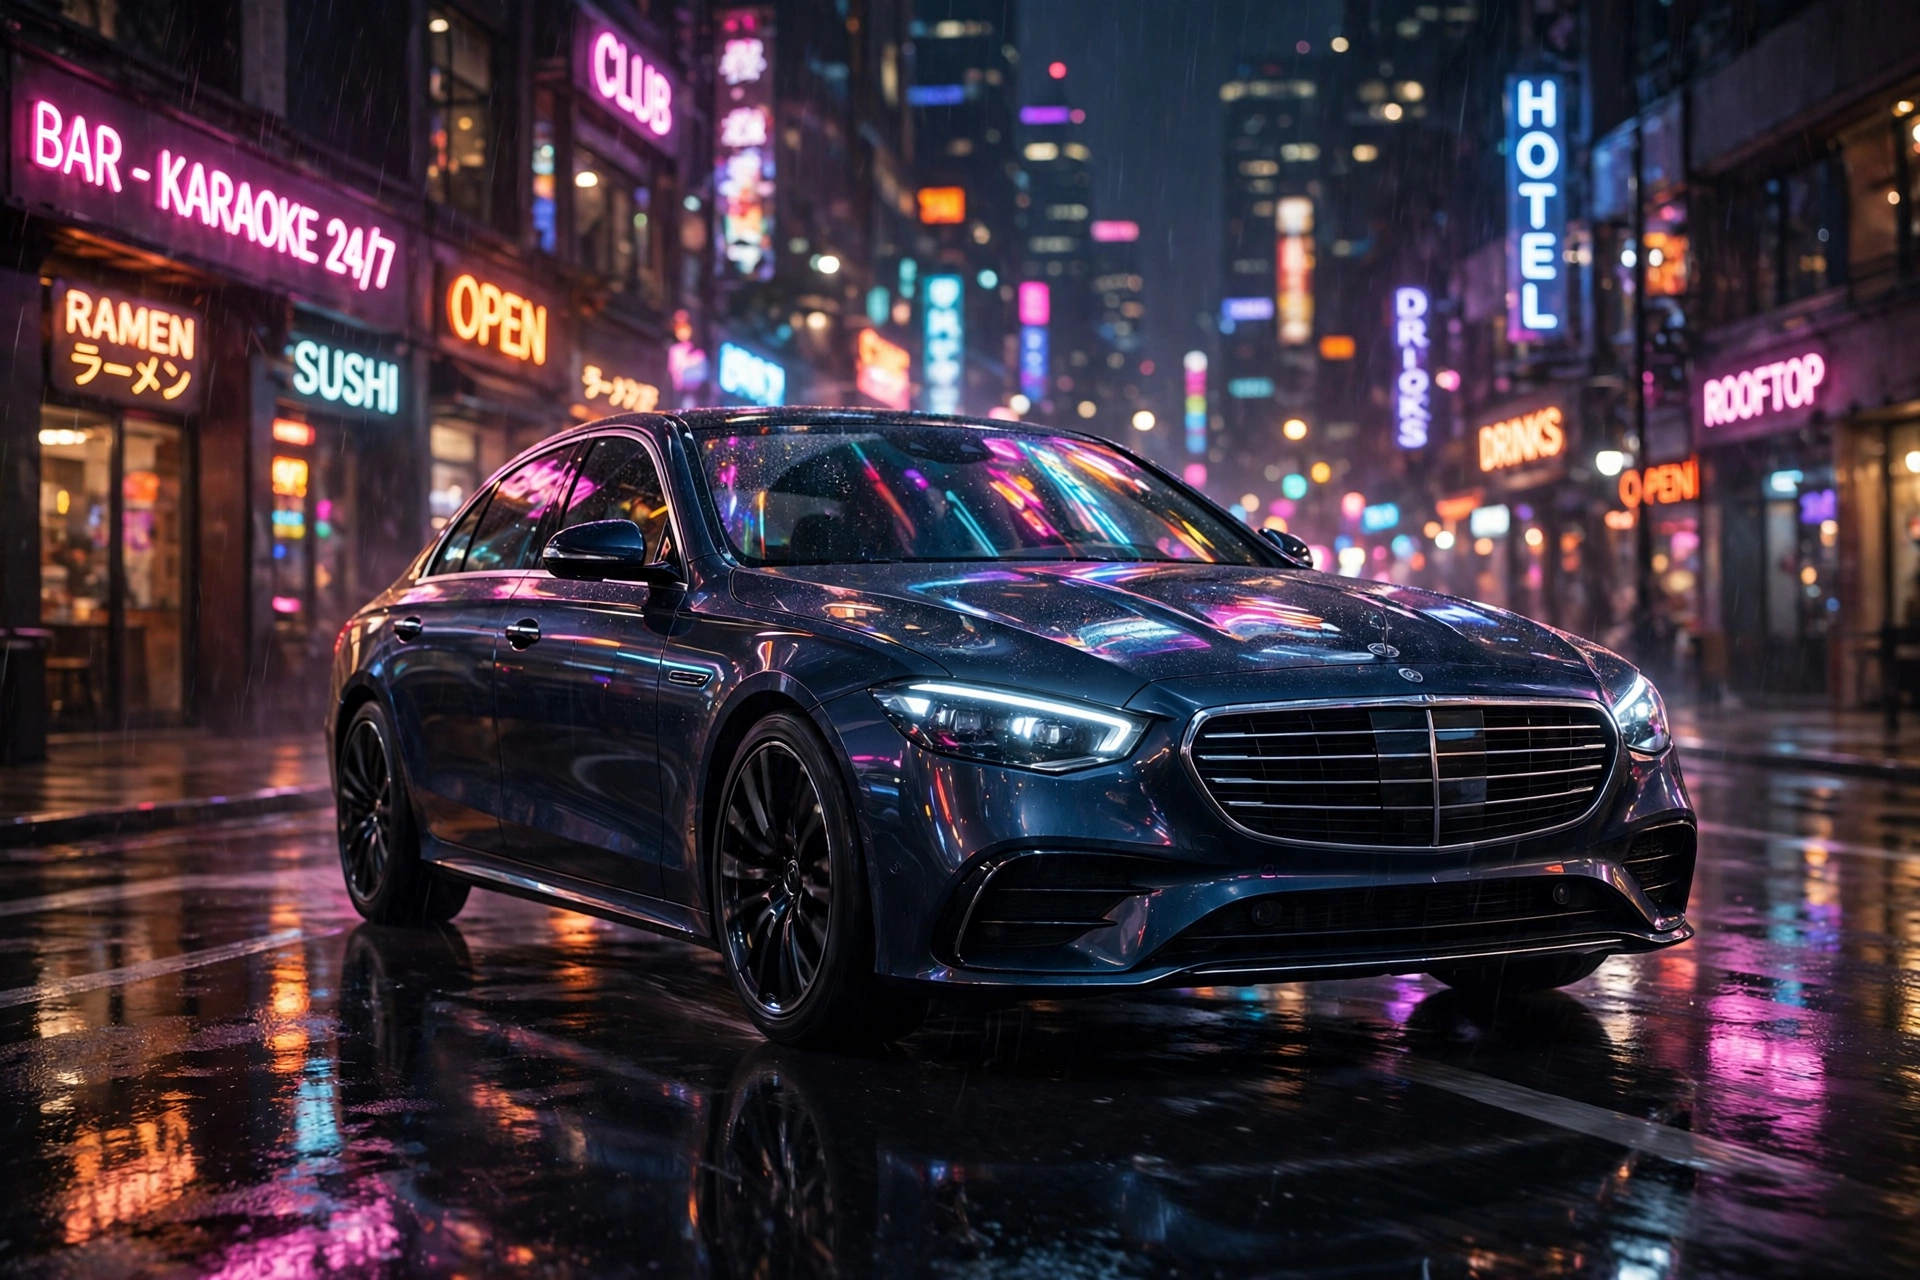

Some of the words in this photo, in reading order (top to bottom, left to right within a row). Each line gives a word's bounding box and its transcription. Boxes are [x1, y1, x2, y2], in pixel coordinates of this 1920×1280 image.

[591, 30, 674, 137] CLUB
[31, 99, 123, 194] BAR
[157, 148, 320, 265] KARAOKE
[325, 217, 397, 292] 24/7
[1514, 78, 1561, 331] HOTEL
[65, 288, 195, 361] RAMEN
[446, 272, 548, 366] OPEN
[70, 341, 192, 400] ラーメン
[293, 340, 399, 414] SUSHI
[1703, 352, 1826, 428] ROOFTOP
